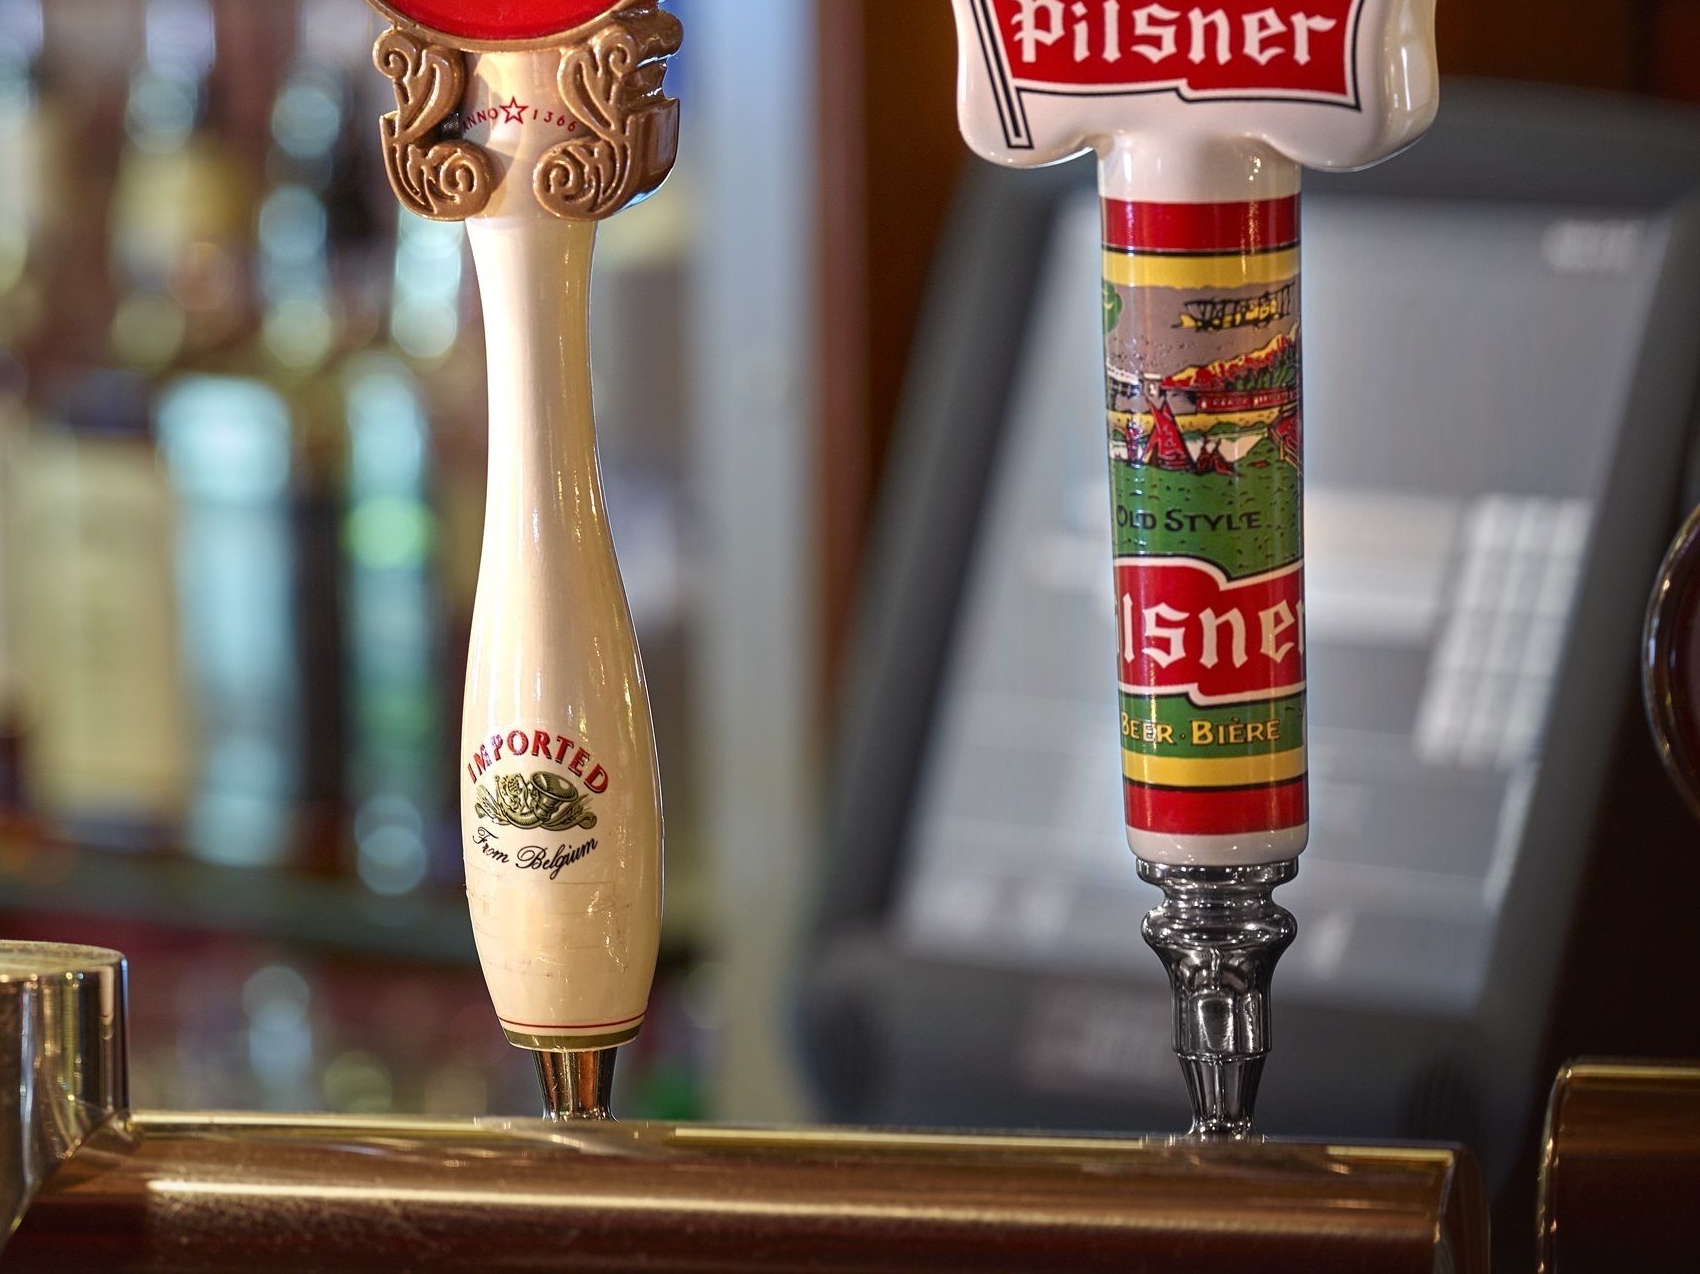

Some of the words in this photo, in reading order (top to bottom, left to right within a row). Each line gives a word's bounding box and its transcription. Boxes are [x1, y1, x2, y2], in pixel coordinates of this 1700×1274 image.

[462, 107, 499, 133] ANNO
[532, 109, 578, 132] 1366
[1116, 504, 1157, 530] OLD
[1163, 508, 1262, 533] STYLE
[467, 730, 610, 795] IMPORTED
[472, 826, 510, 864] From
[515, 837, 599, 880] Belgium
